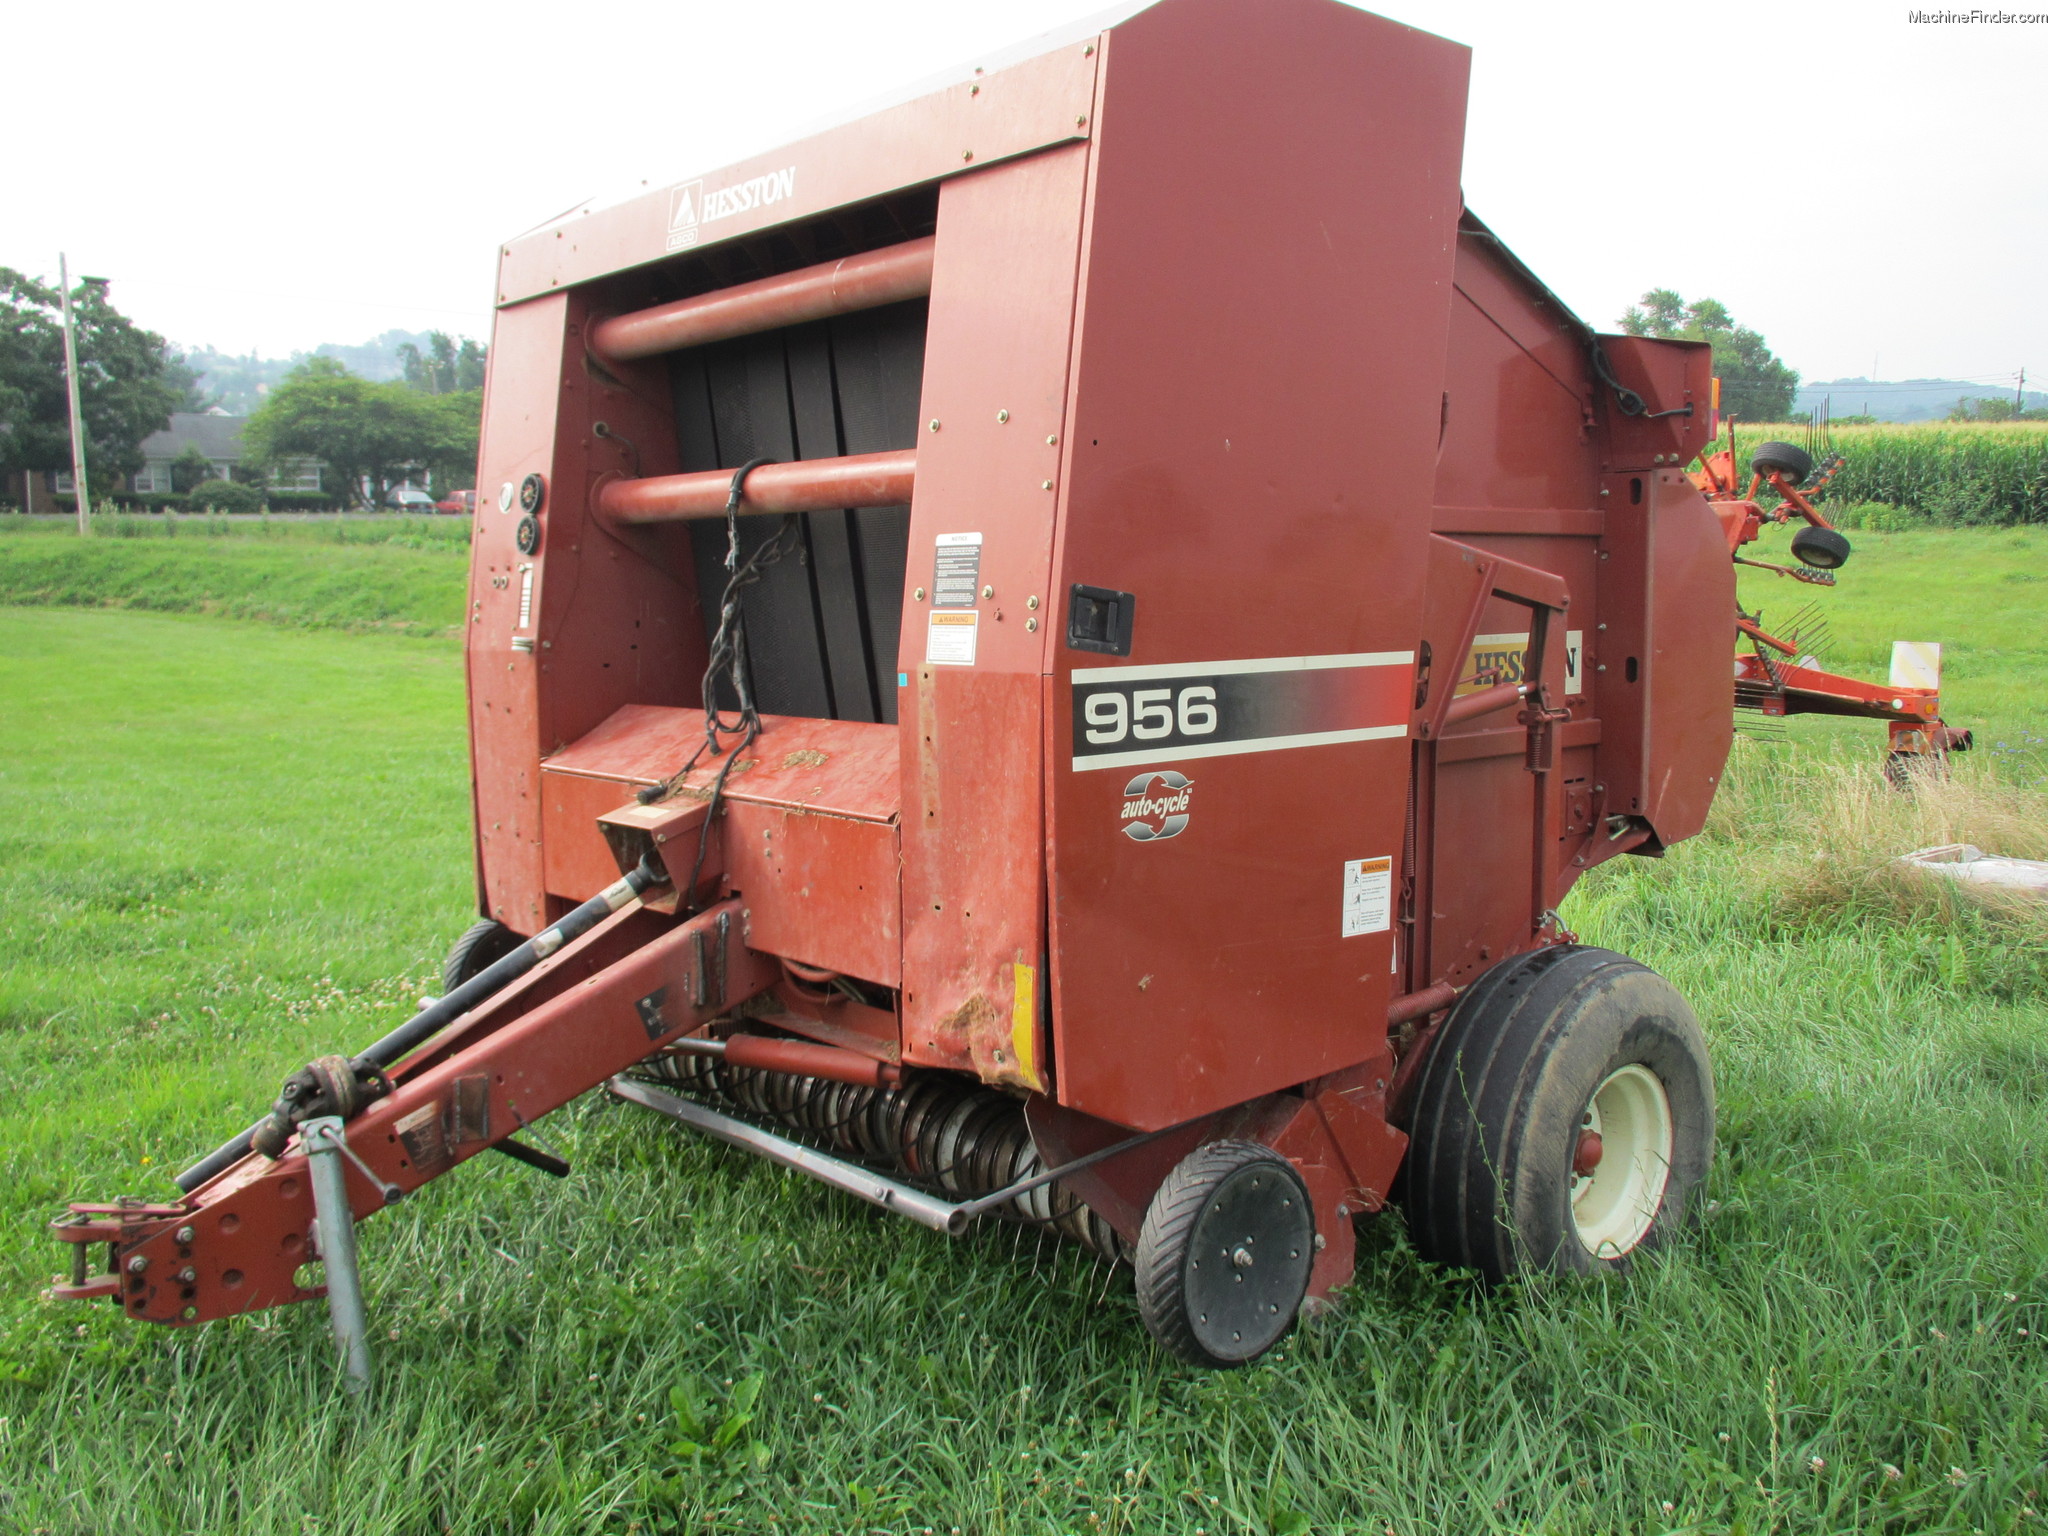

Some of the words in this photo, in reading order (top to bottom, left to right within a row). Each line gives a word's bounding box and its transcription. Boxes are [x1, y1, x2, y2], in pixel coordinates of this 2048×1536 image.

[702, 166, 796, 224] HESSTON
[943, 615, 970, 623] WARNING
[1085, 686, 1217, 744] 956
[1120, 790, 1190, 820] auto-cycle
